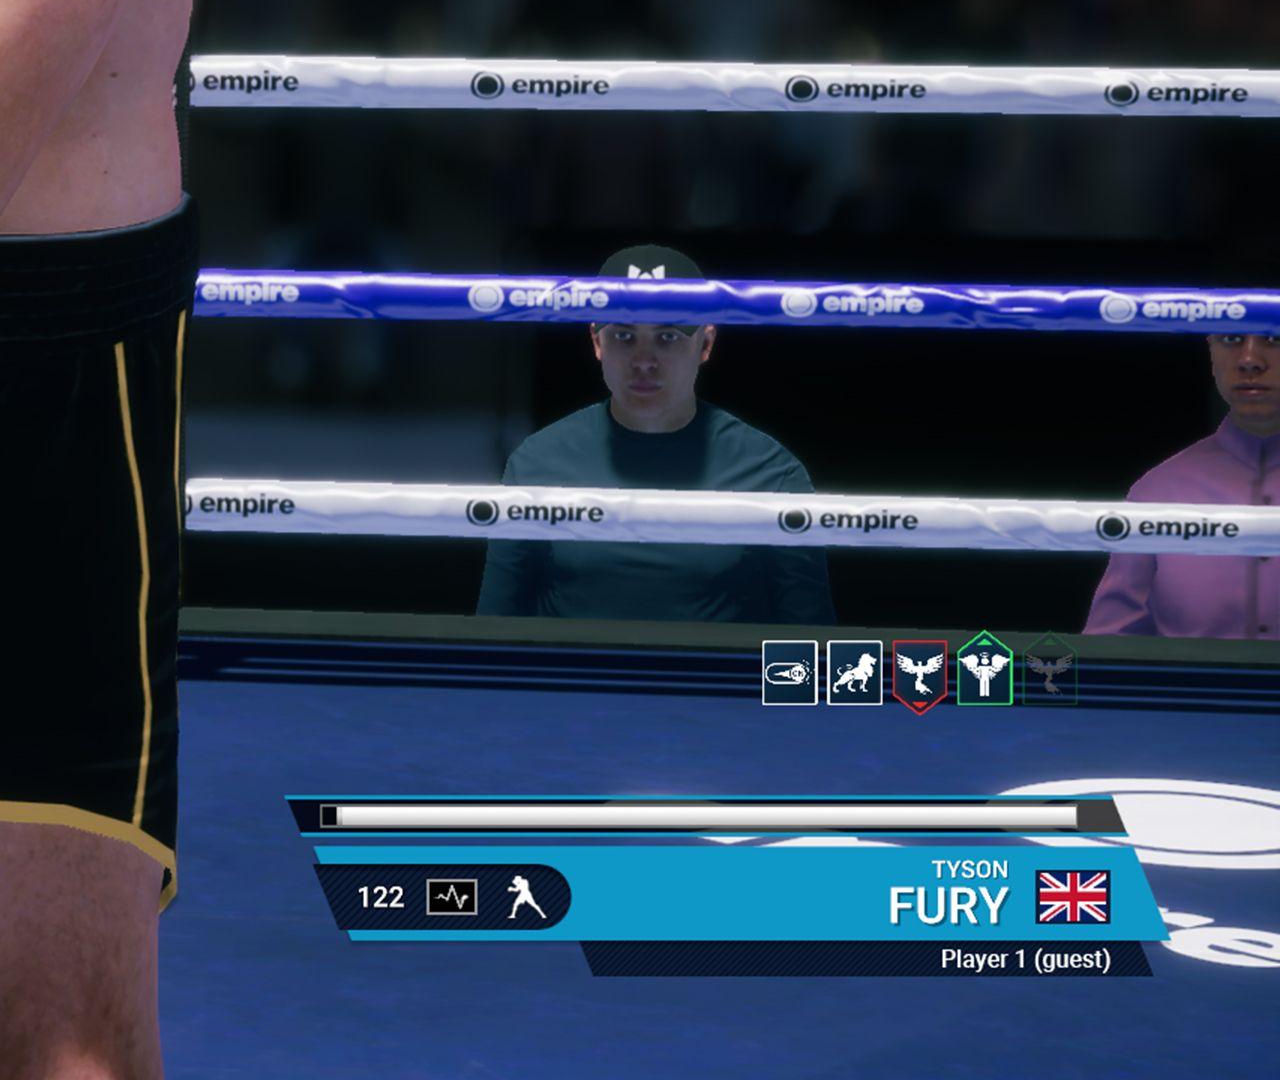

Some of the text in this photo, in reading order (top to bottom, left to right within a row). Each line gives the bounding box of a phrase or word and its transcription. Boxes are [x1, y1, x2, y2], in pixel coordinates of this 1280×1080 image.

[203, 72, 299, 93] empire
[512, 75, 609, 97] empire
[827, 80, 925, 100] empire
[1148, 83, 1247, 105] empire
[202, 282, 299, 305] empire
[510, 286, 608, 310] empire
[824, 293, 923, 316] empire
[1142, 298, 1245, 322] empire
[200, 494, 294, 518] empire
[507, 503, 603, 525] empire
[820, 511, 918, 532] empire
[1139, 518, 1239, 539] empire
